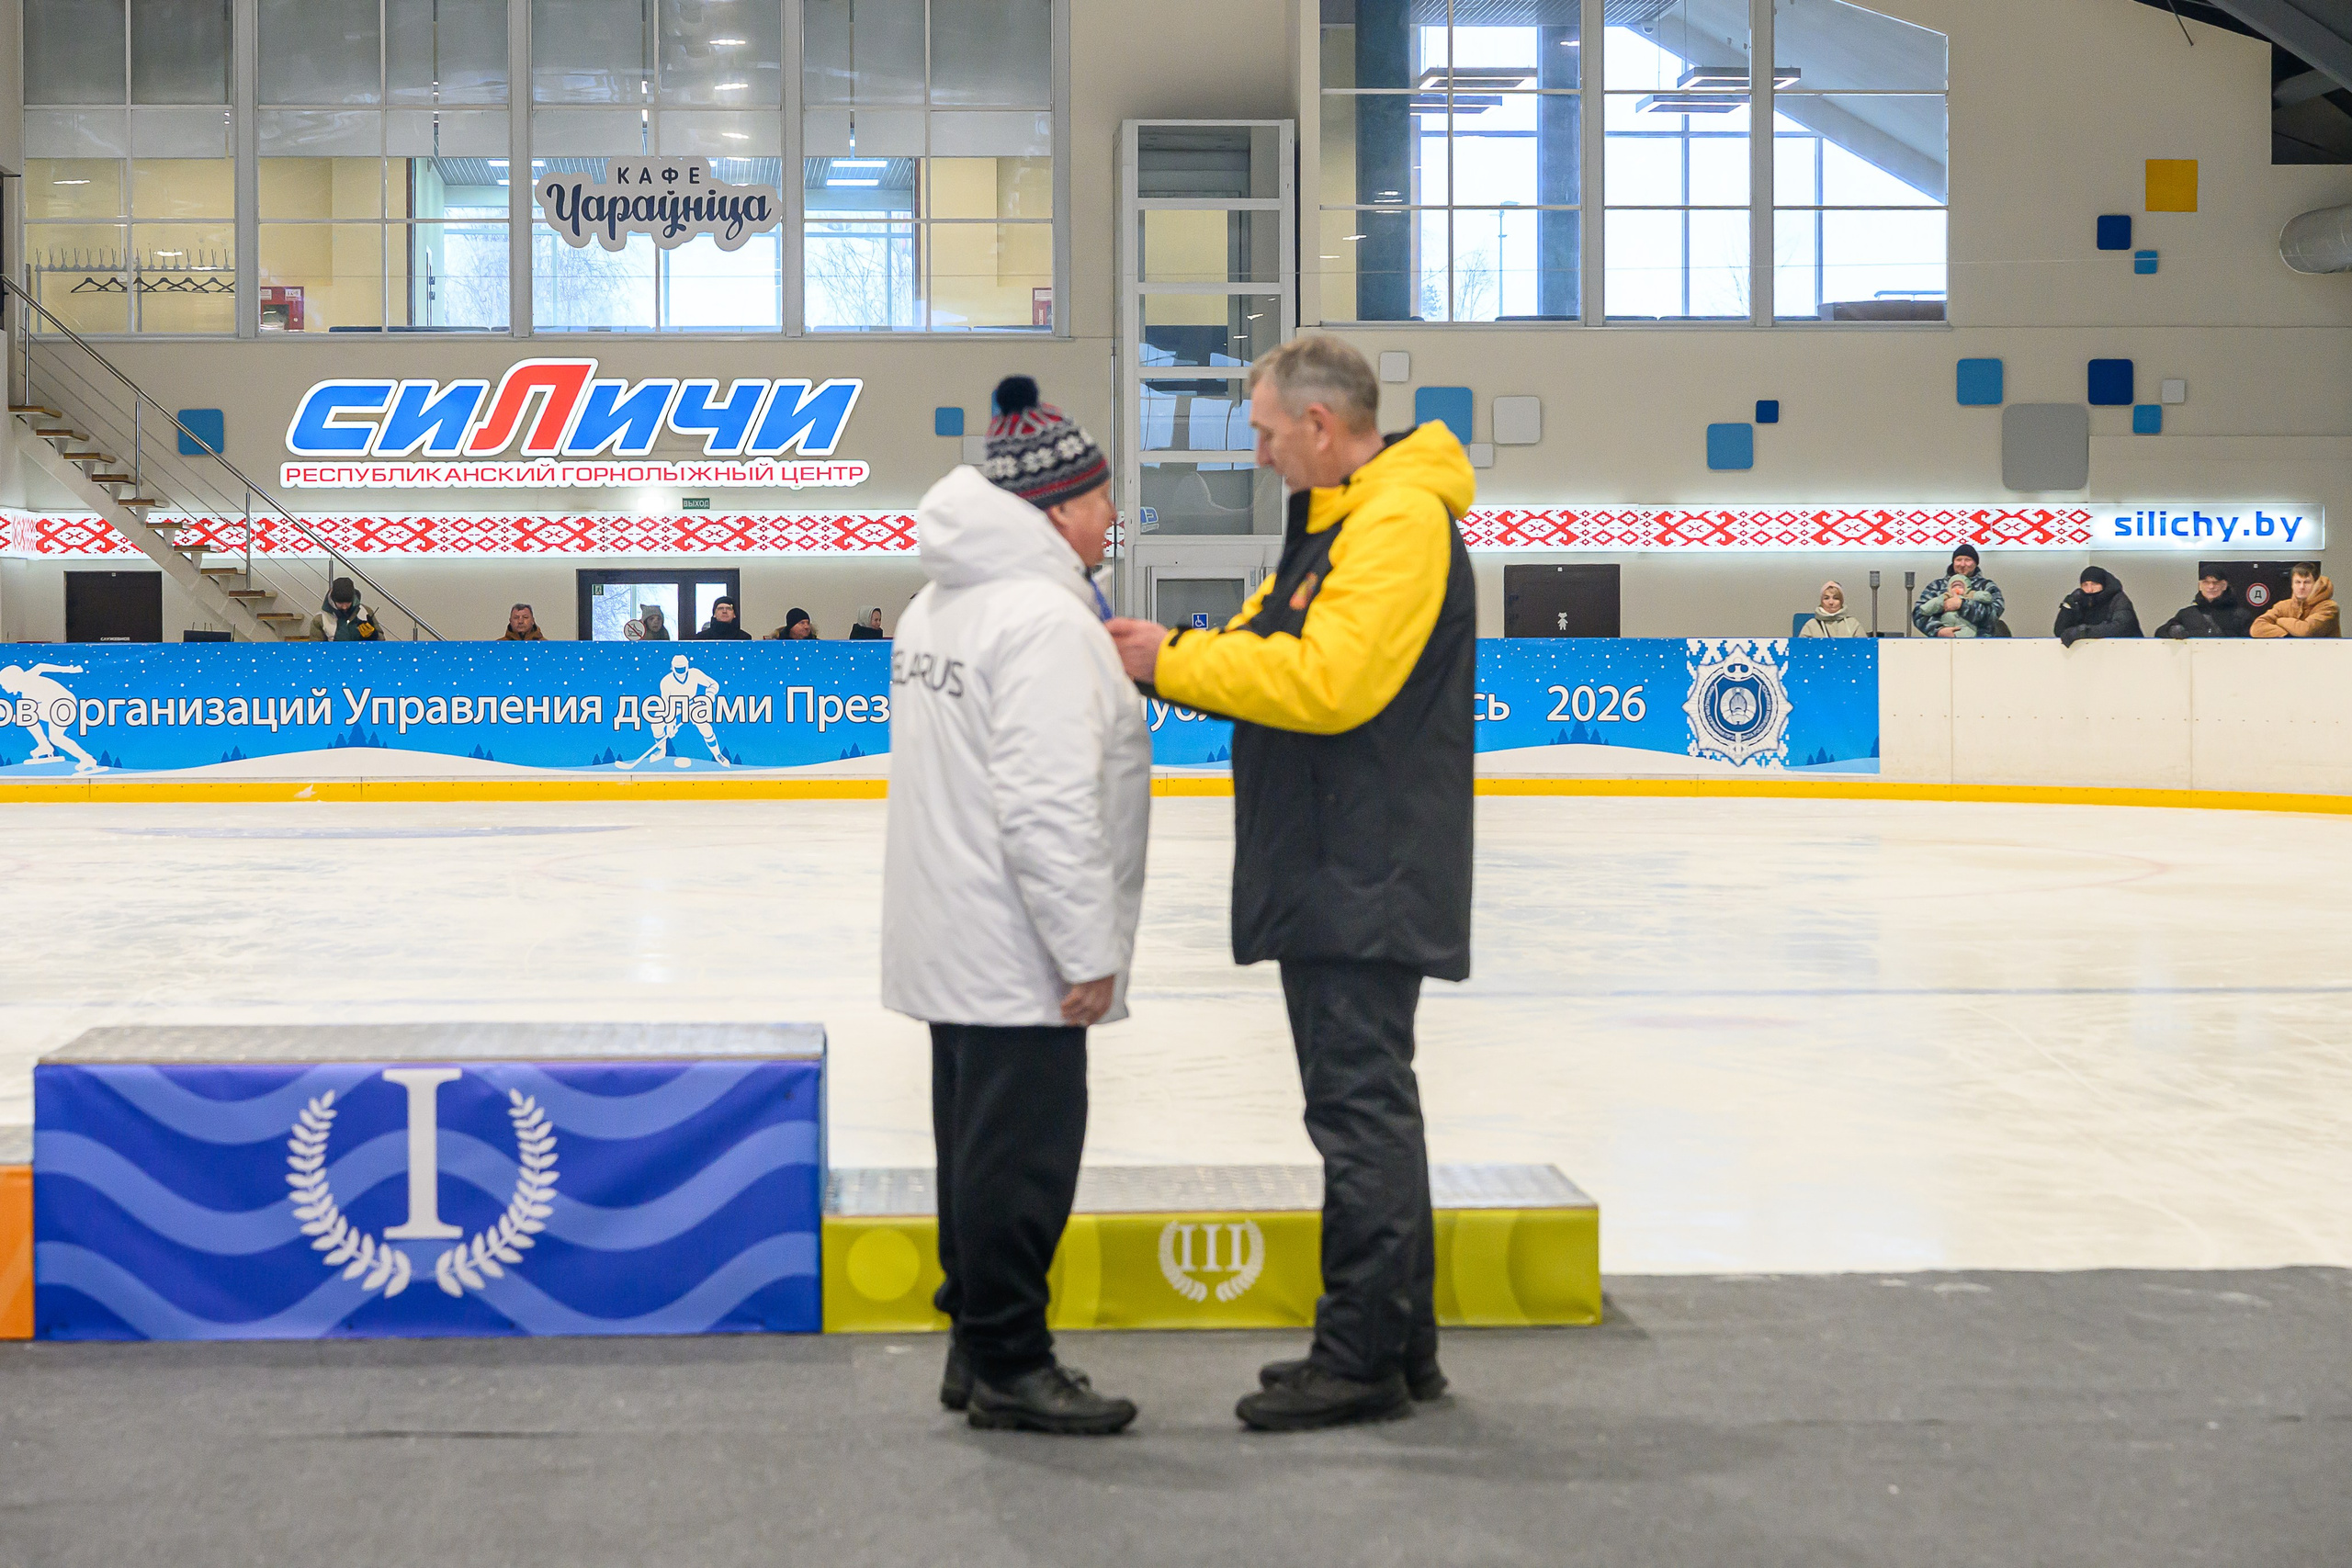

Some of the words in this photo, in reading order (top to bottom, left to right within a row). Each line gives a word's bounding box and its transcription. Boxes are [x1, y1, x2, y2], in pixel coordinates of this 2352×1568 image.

[617, 167, 700, 185] КАФЕ
[546, 183, 772, 241] Чараўніца
[286, 463, 555, 482] РЕСПУБЛИКАНСКИЙ
[562, 463, 774, 482] ГОРНОЛЫЖНЫЙ
[781, 466, 864, 484] ЦЕНТР
[683, 500, 709, 508] ВЫХОД
[2115, 511, 2303, 542] silichy.by
[50, 687, 332, 737] организаций
[342, 687, 603, 735] Управления
[613, 694, 774, 731] делами
[1545, 684, 1647, 723] 2026
[1177, 1223, 1248, 1272] III
